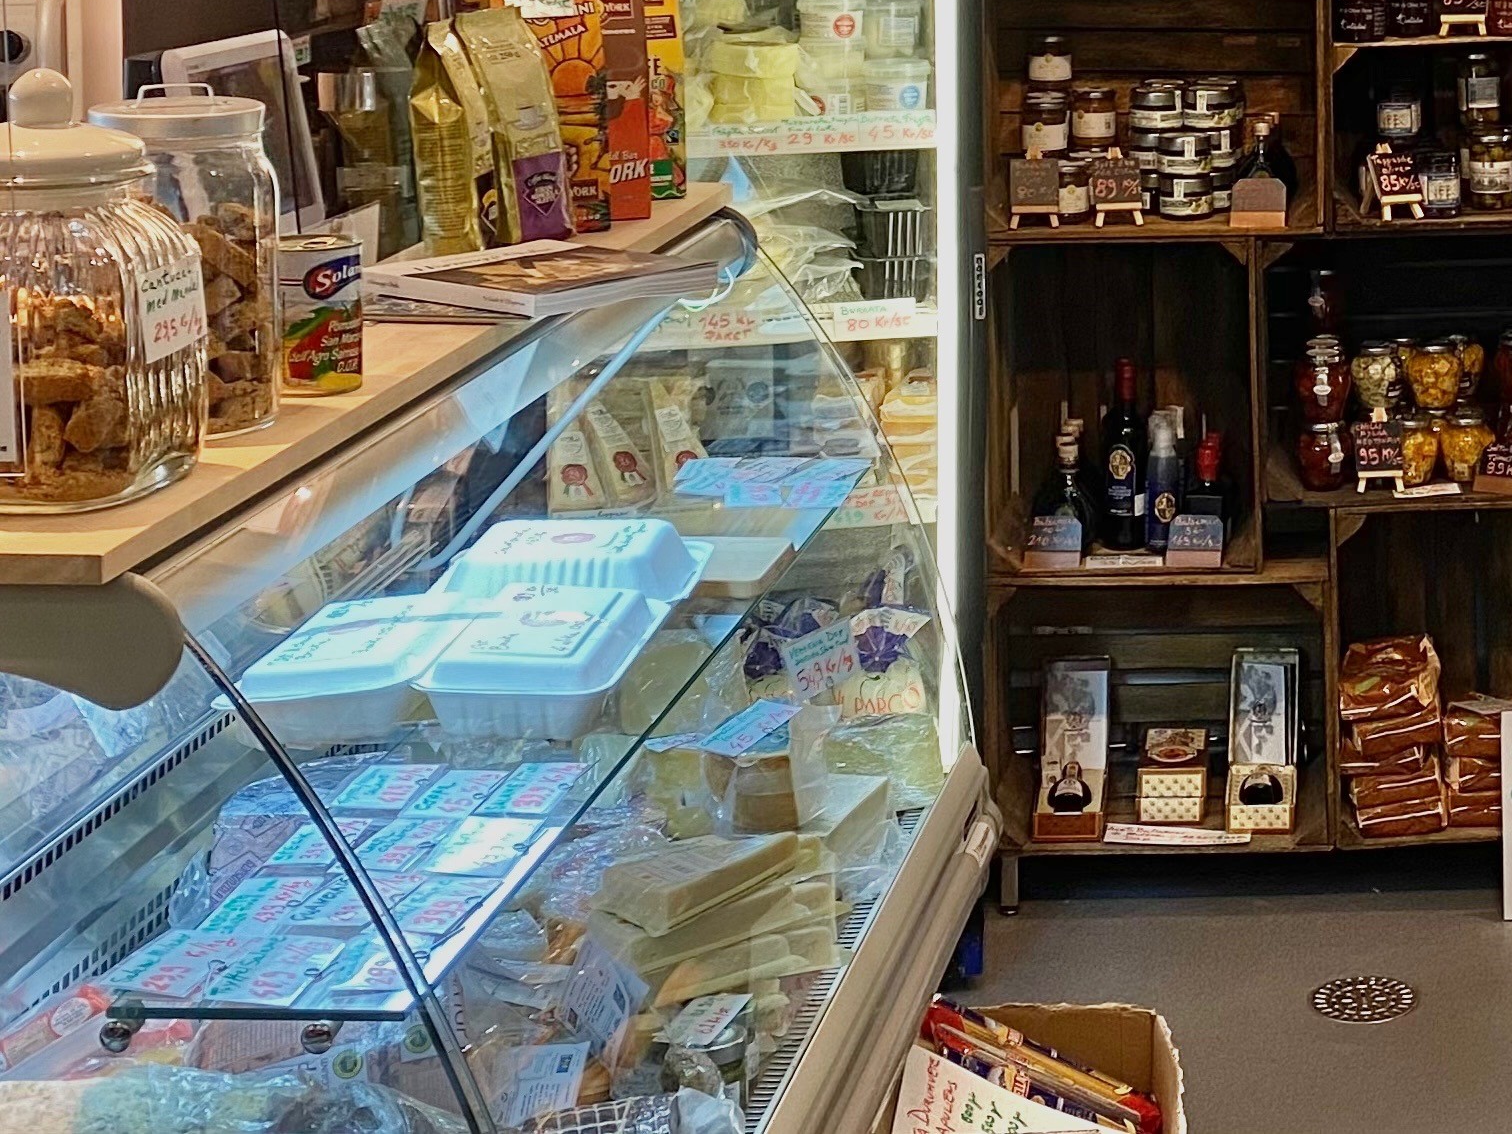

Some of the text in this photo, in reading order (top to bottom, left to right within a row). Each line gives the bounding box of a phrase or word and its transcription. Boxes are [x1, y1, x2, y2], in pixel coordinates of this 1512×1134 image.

[868, 126, 894, 142] 45
[610, 159, 649, 183] ORK
[848, 319, 869, 331] 80
[1359, 448, 1379, 465] 95
